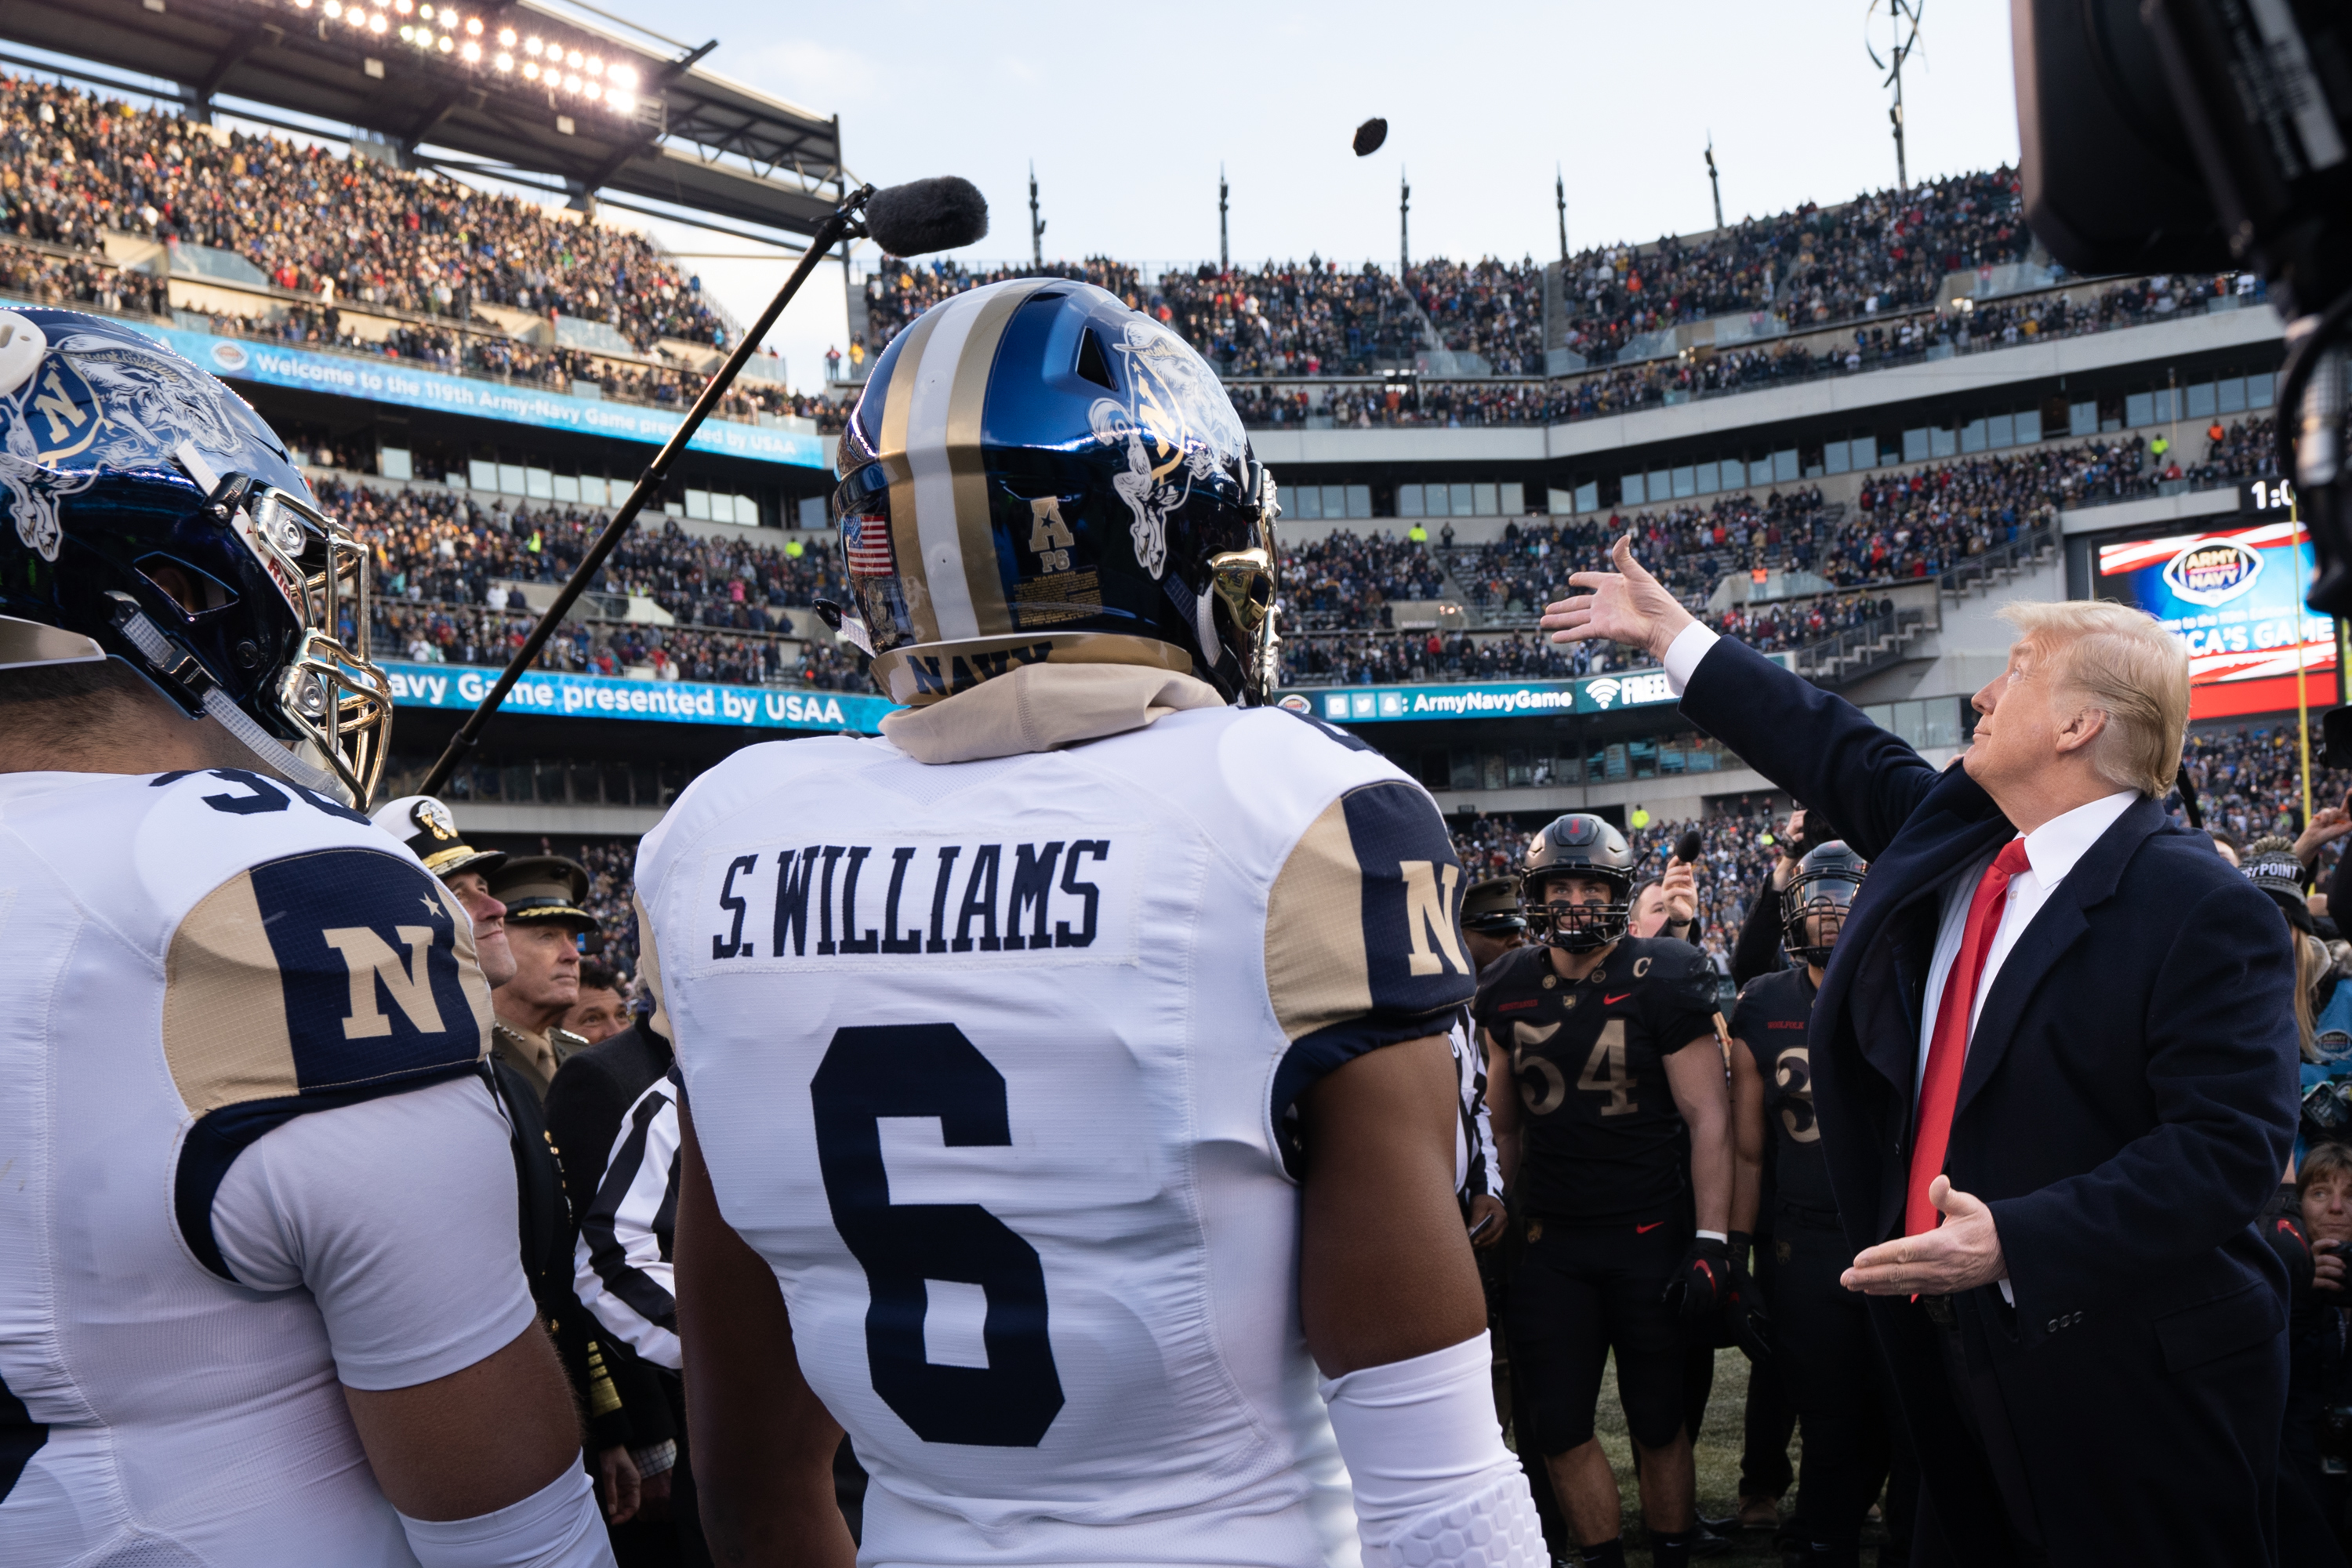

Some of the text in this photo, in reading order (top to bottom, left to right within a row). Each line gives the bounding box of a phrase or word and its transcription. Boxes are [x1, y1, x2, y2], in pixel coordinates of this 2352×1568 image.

[34, 370, 88, 445] N
[256, 352, 356, 384] Welcome
[360, 369, 383, 390] to
[387, 375, 420, 397] the
[424, 381, 474, 403] 119th
[478, 393, 581, 426] Army-Navy
[584, 406, 637, 430] Game
[727, 430, 747, 452] by
[750, 435, 797, 456] USAA
[1138, 373, 1176, 459] N
[1033, 570, 1076, 583] WARNING
[2186, 549, 2238, 569] ARMY
[2188, 570, 2239, 589] NAVY
[2253, 617, 2335, 650] GAME
[564, 683, 719, 721] presented
[723, 691, 757, 724] by
[764, 693, 845, 724] USAA
[1414, 689, 1573, 713] ArmyNavyGame
[1621, 673, 1676, 705] FREE
[2259, 862, 2299, 880] POINT
[773, 839, 1111, 959] WILLIAMS
[1400, 859, 1470, 978] N
[321, 925, 446, 1040] N
[1632, 956, 1653, 978] C
[1513, 1019, 1640, 1116] 54
[809, 1022, 1065, 1447] 6
